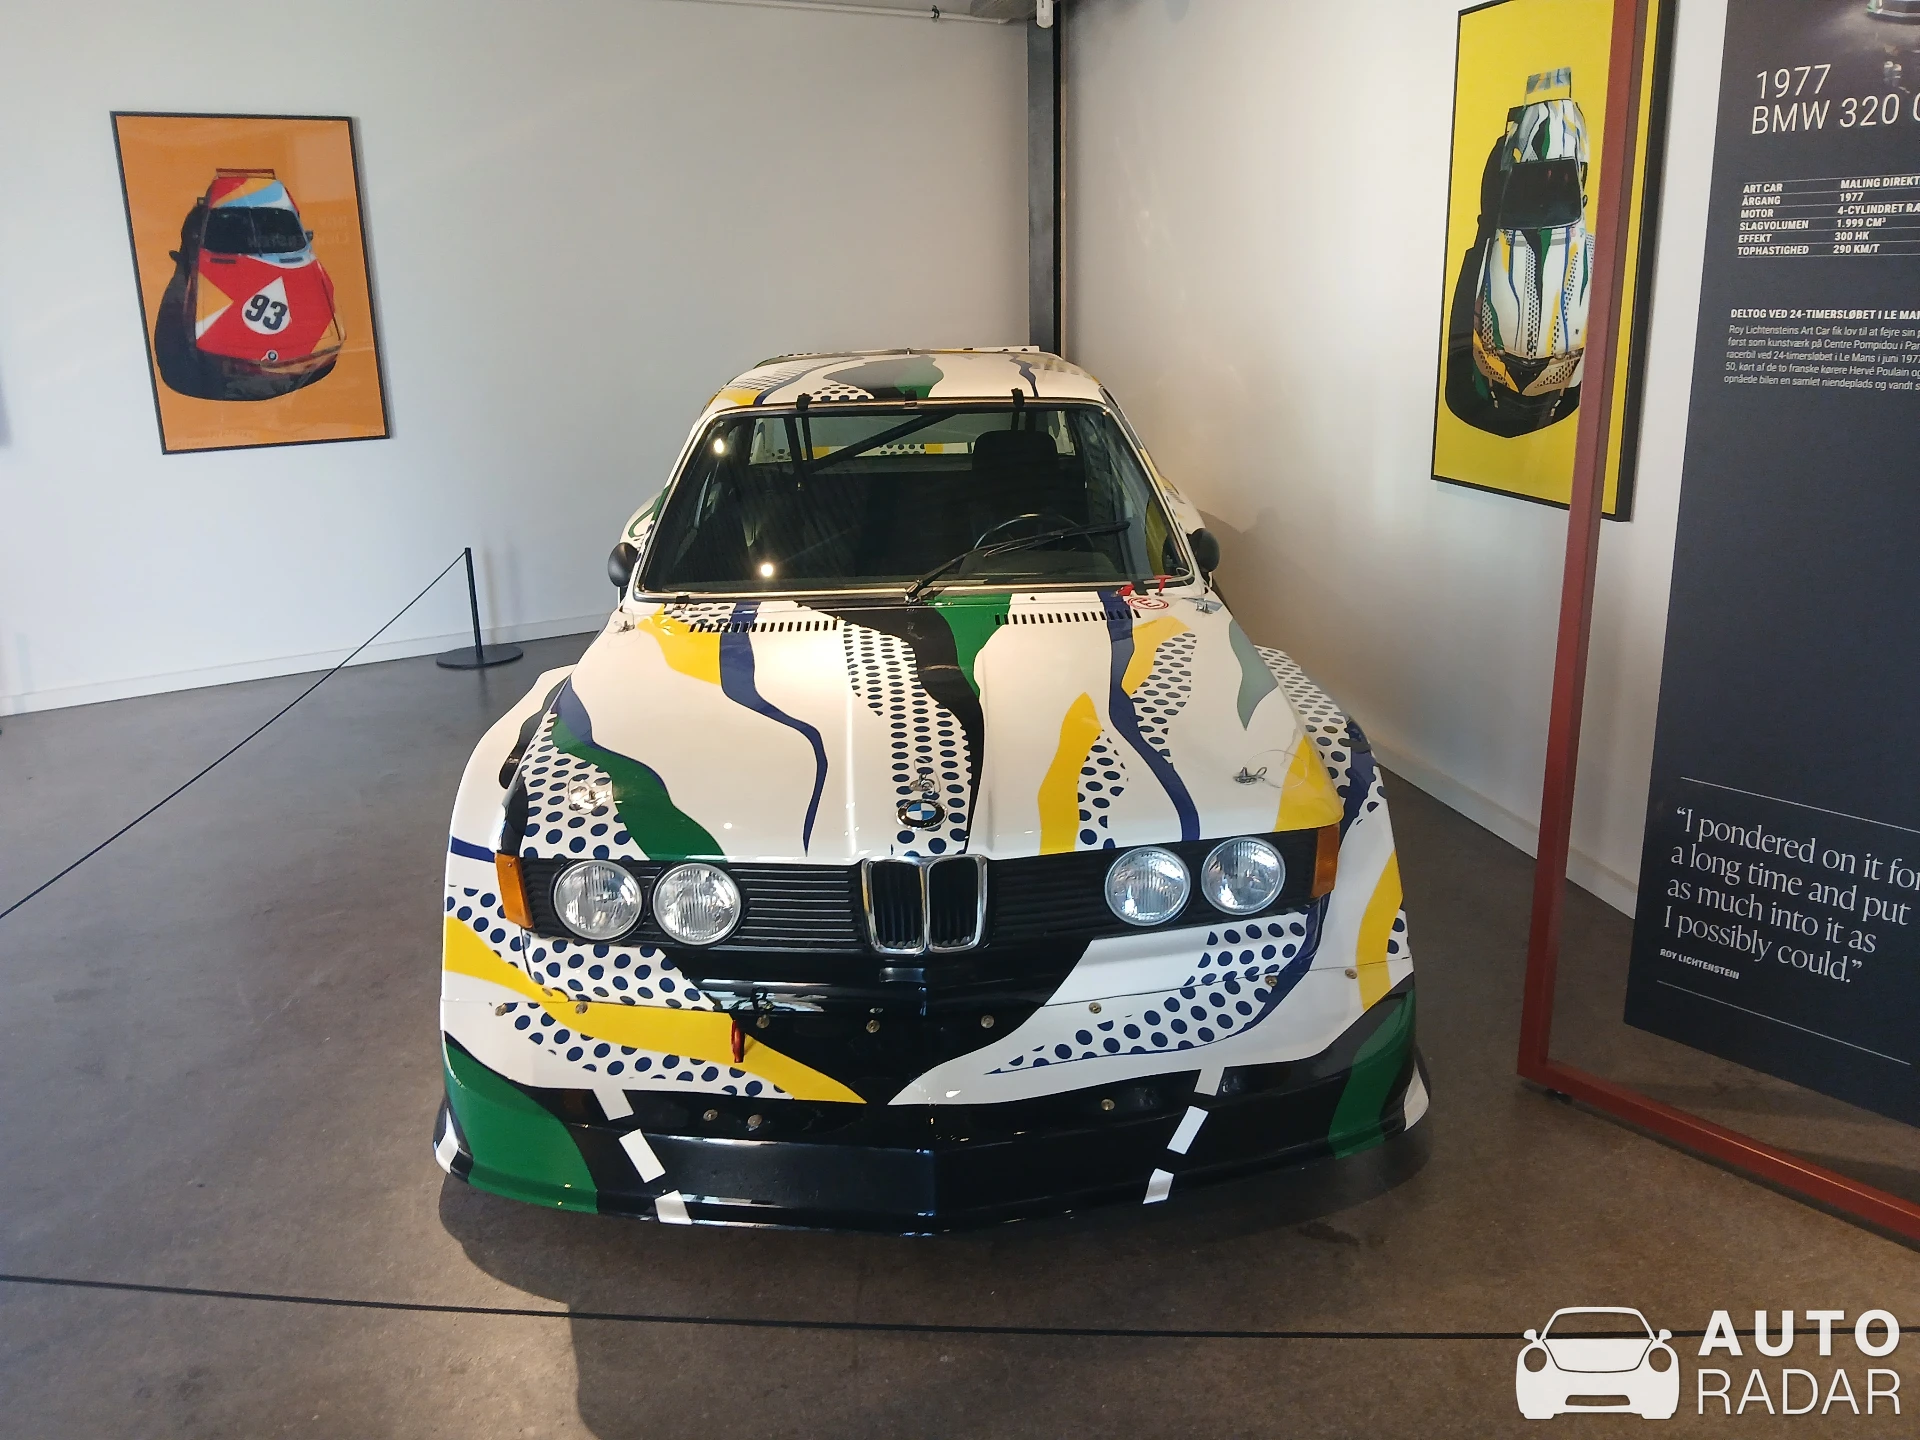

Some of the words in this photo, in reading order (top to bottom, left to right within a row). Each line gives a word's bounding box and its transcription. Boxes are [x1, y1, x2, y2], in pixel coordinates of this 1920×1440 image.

[1756, 64, 1832, 99] 1977
[1752, 100, 1830, 134] BMW
[1840, 94, 1900, 128] 320
[1840, 178, 1880, 188] MALING
[1882, 176, 1920, 187] DIREKT
[1743, 184, 1762, 194] ART
[1764, 183, 1783, 193] CAR
[1742, 194, 1781, 206] ÅRGANG
[1840, 192, 1864, 202] 1977
[1740, 208, 1774, 218] MOTOR
[1838, 204, 1904, 215] 4-CYLINDRET
[1740, 220, 1809, 230] SLAGVOLUMEN
[1836, 218, 1864, 228] 1.999
[1738, 234, 1772, 244] EFFEKT
[1834, 232, 1853, 242] 300
[1854, 231, 1870, 240] HK
[1737, 246, 1810, 256] TOPHASTIGHED
[1833, 244, 1852, 254] 290
[1853, 244, 1880, 254] KM/T
[244, 294, 288, 331] 93
[1730, 308, 1767, 318] DELTOG
[1768, 309, 1788, 318] VED
[1790, 309, 1876, 320] 24-TIMERSLØBET
[1884, 310, 1898, 320] LE
[1728, 324, 1744, 336] Roy
[1746, 325, 1799, 335] Lichtensteins
[1800, 326, 1814, 335] Art
[1815, 326, 1830, 336] Car
[1844, 326, 1858, 336] lov
[1868, 328, 1878, 336] at
[1902, 328, 1916, 337] sin
[1748, 338, 1766, 347] som
[1768, 338, 1810, 348] kunstværk
[1811, 338, 1822, 350] på
[1824, 339, 1852, 348] Centre
[1854, 340, 1898, 351] Pompidou
[1758, 350, 1772, 360] ved
[1840, 352, 1850, 362] Le
[1852, 352, 1876, 362] Mans
[1756, 362, 1766, 372] af
[1766, 362, 1777, 372] de
[1778, 364, 1788, 372] to
[1788, 364, 1820, 374] franske
[1849, 366, 1874, 376] Hervé
[1876, 366, 1910, 377] Poulain
[1758, 374, 1778, 384] bilen
[1780, 377, 1791, 385] en
[1875, 381, 1886, 391] og
[1888, 380, 1914, 390] vandt
[1698, 818, 1816, 864] pondered
[1822, 849, 1856, 874] on
[1863, 852, 1884, 881] it
[1888, 858, 1920, 891] for
[1670, 846, 1684, 865] a
[1690, 844, 1742, 886] long
[1748, 862, 1802, 896] time
[1808, 882, 1857, 911] and
[1862, 896, 1912, 926] put
[1667, 878, 1691, 900] as
[1697, 886, 1763, 921] much
[1770, 901, 1818, 936] into
[1825, 917, 1844, 944] it
[1848, 930, 1876, 952] as
[1664, 905, 1672, 928] I
[1677, 914, 1772, 962] possibly
[1777, 944, 1862, 983] could.”
[1660, 948, 1678, 960] ROY
[1678, 954, 1740, 980] LICHTENSTEIN
